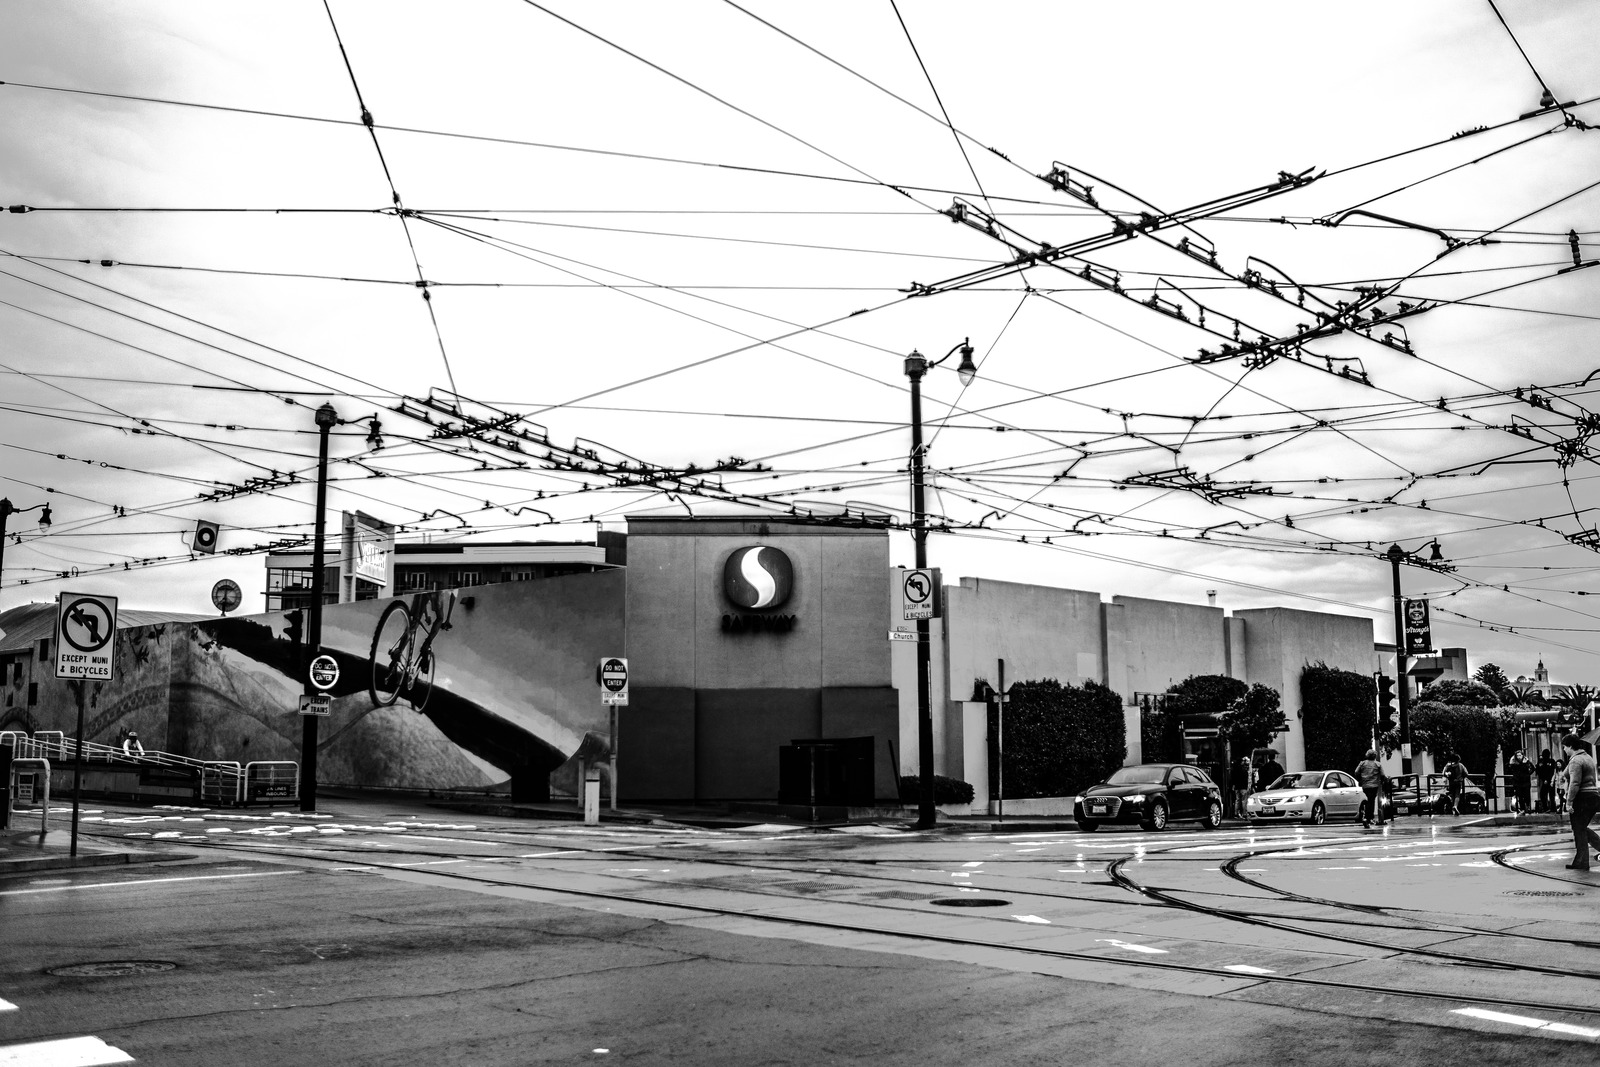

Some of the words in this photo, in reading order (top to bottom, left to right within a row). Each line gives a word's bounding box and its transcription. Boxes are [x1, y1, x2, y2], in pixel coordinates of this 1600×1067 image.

[722, 614, 795, 631] SAFEWAY
[893, 632, 914, 640] Church
[61, 654, 87, 663] EXCEPT
[91, 656, 109, 665] MUNI
[314, 662, 322, 670] DO
[60, 665, 66, 673] &
[70, 665, 109, 676] BICYCLES
[315, 673, 333, 681] ENTER
[310, 697, 329, 705] EXCEPT
